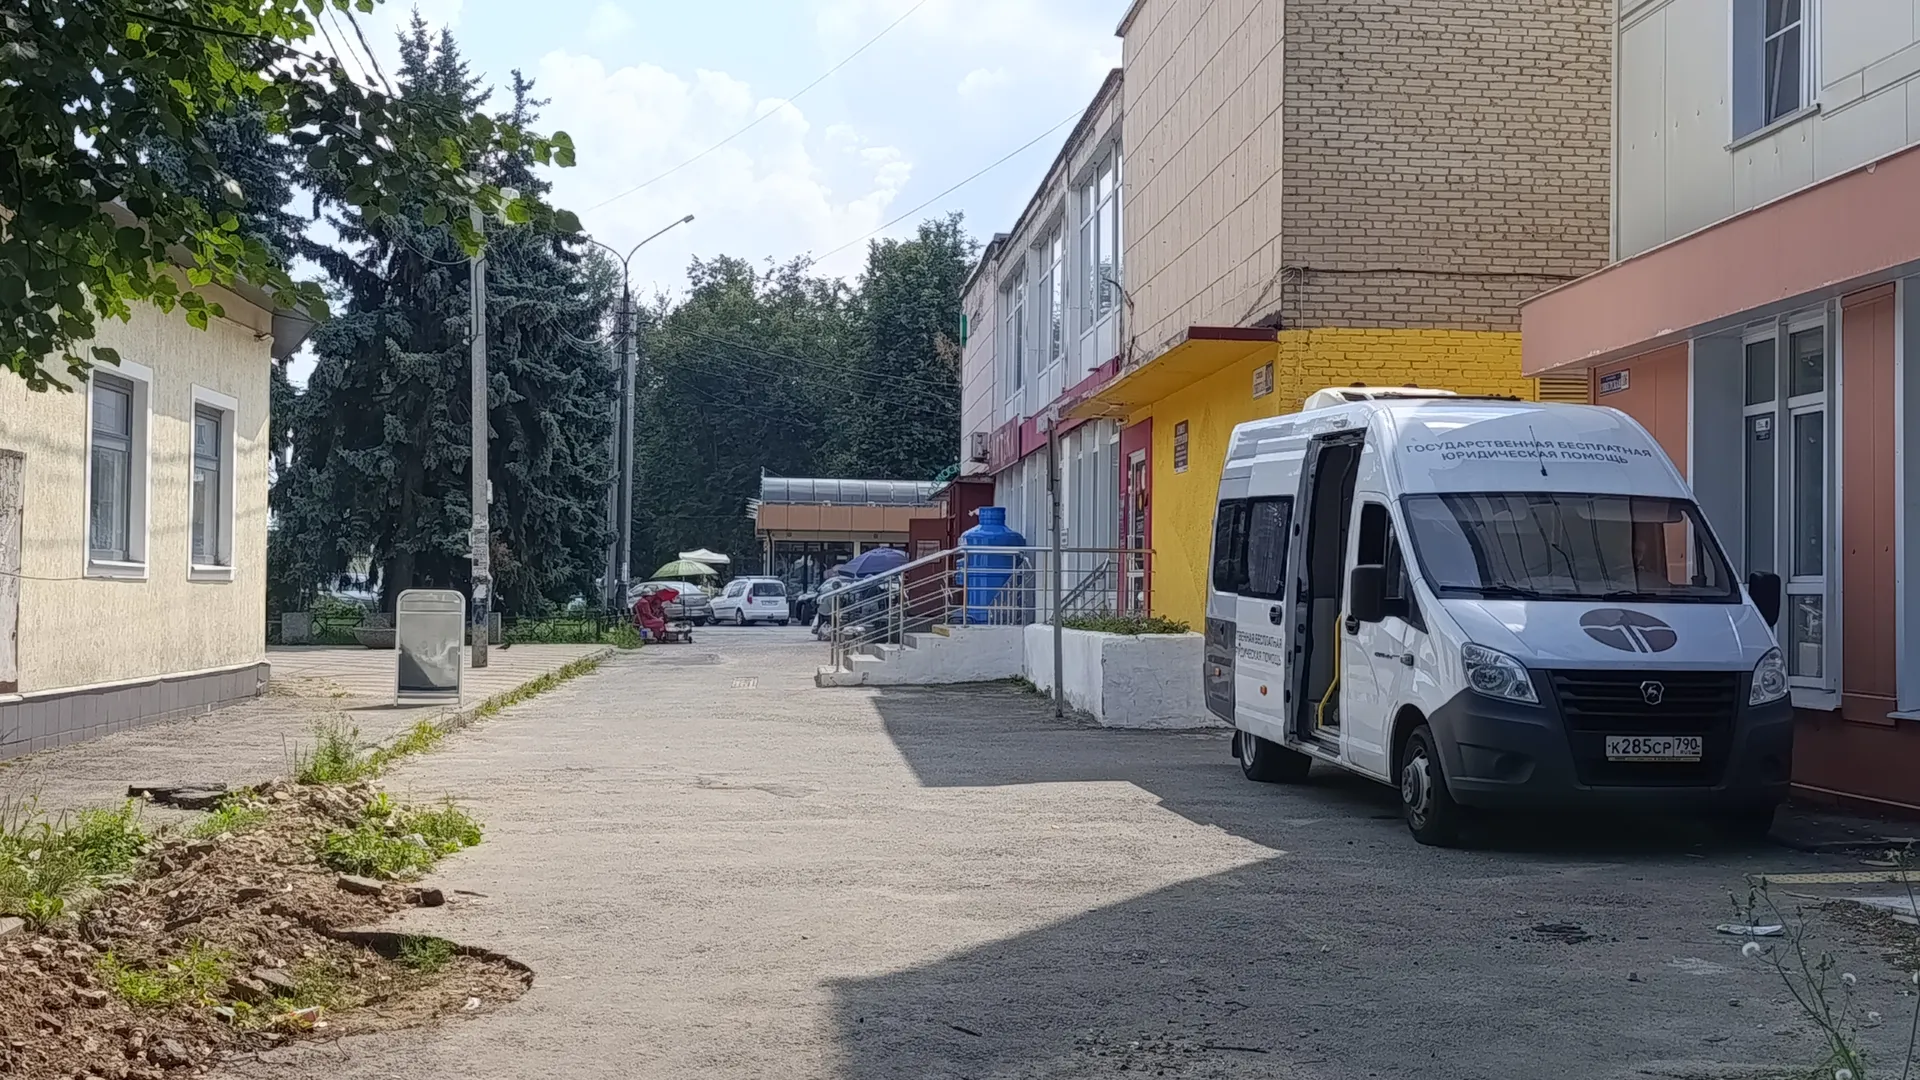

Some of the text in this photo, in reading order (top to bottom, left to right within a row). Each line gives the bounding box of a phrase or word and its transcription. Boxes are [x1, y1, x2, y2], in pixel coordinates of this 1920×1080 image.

[1406, 440, 1652, 457] ГОСУДАРСТВЕННАЯ БЕСПЛАТНАЯ
[1441, 450, 1629, 464] ЮРИДИЧЕСКАЯ ПОМОЩЬ
[1611, 738, 1698, 754] К285СР 790
